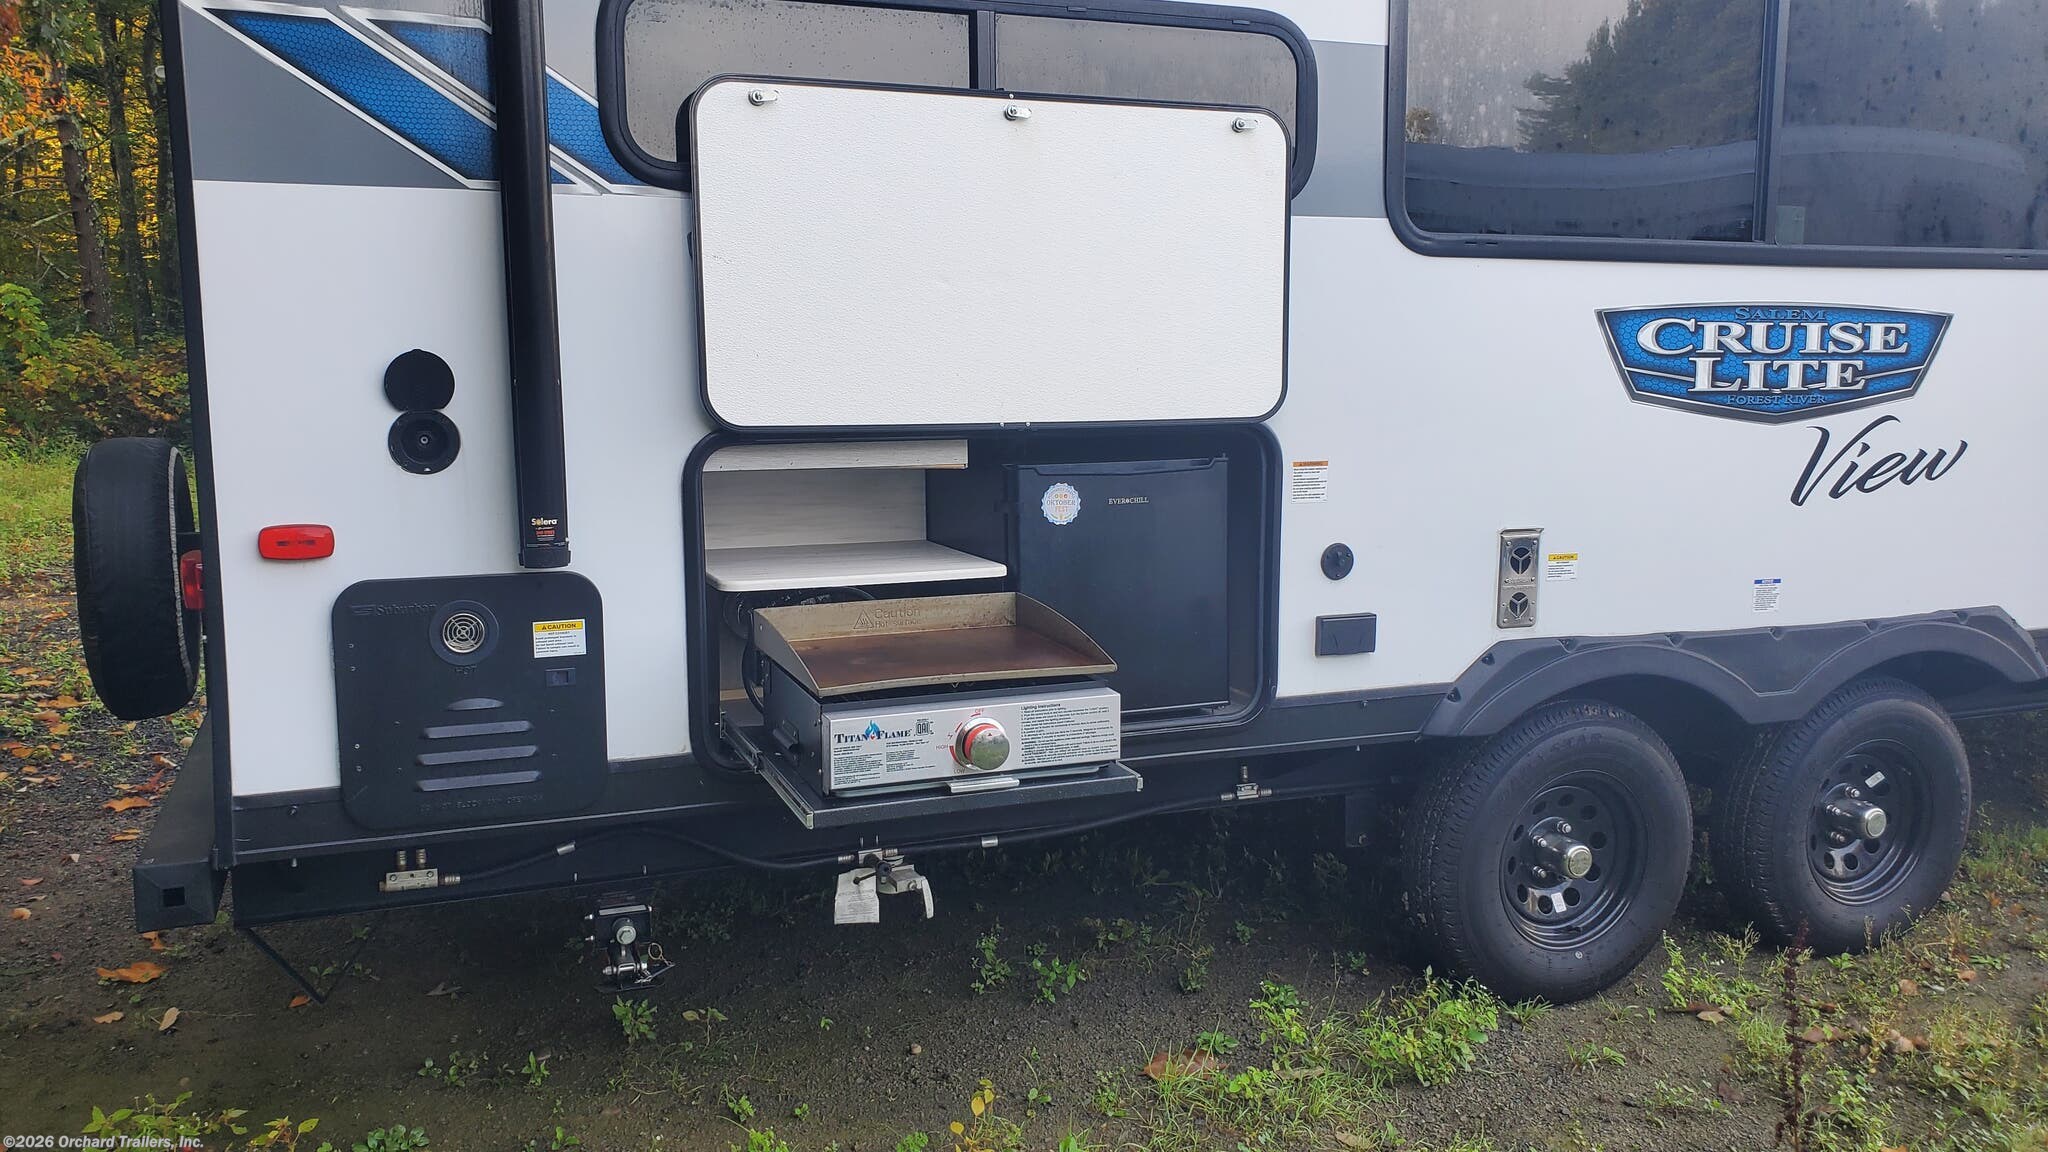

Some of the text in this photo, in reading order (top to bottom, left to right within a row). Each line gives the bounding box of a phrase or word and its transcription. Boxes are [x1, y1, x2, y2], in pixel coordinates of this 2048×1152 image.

[1734, 306, 1827, 321] SALEM
[1636, 317, 1909, 356] CRUISE
[1687, 356, 1868, 393] LITE
[1727, 393, 1826, 405] FOREST RIVER
[1790, 414, 1968, 507] View
[531, 517, 558, 526] Solera
[874, 608, 921, 619] Caution
[547, 623, 577, 631] CAUTION
[834, 729, 911, 744] TITAN FLAME
